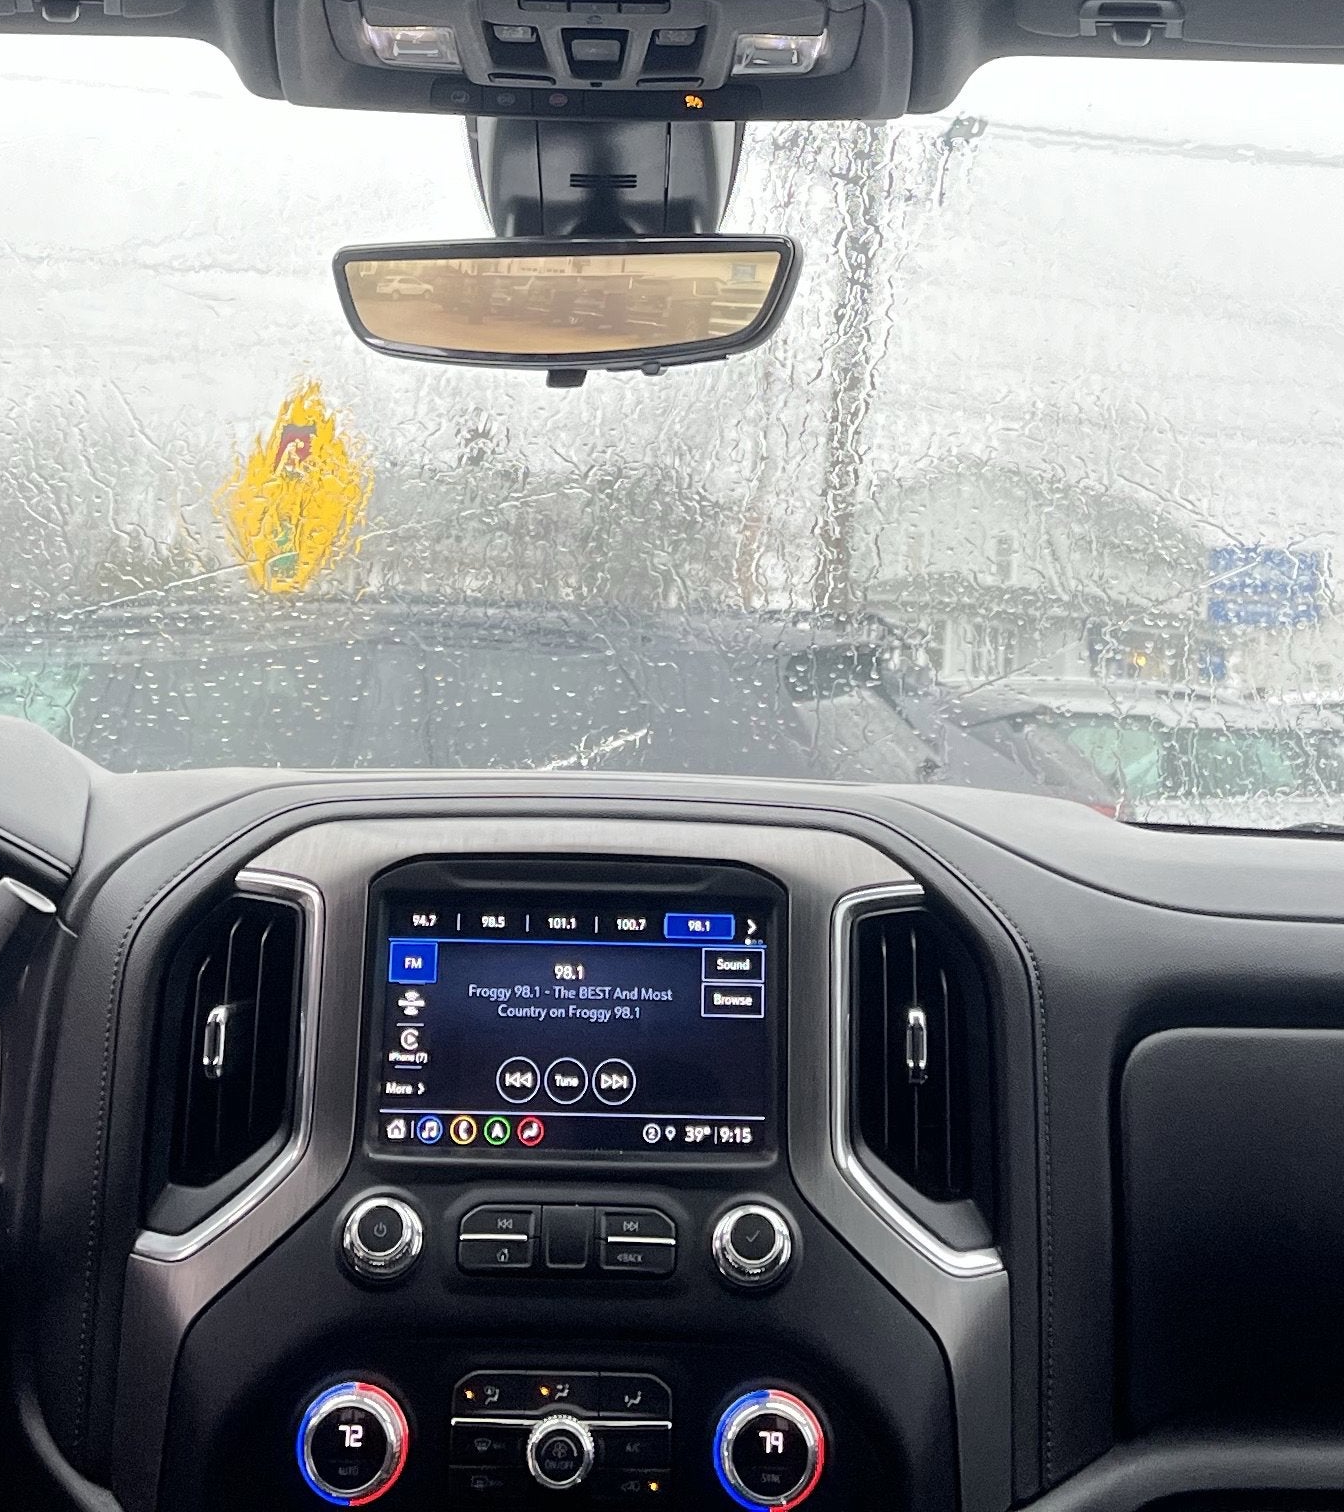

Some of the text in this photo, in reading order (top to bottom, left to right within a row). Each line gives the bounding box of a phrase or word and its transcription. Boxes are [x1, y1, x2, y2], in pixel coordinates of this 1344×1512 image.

[412, 914, 437, 927] 94.7
[481, 916, 505, 928] 98.5
[548, 917, 576, 929] 101.1
[617, 918, 647, 931] 100.7
[688, 920, 710, 932] 98.1
[404, 957, 422, 969] FM
[716, 958, 751, 971] Sound
[554, 964, 585, 980] 98.1
[468, 984, 511, 1001] Froggy
[514, 985, 540, 999] 98.1
[553, 986, 576, 999] The
[579, 986, 612, 1000] BEST
[613, 987, 638, 1000] And
[641, 987, 673, 1001] Most
[713, 993, 753, 1006] Browse
[498, 1004, 641, 1022] Country on Froggy 98.1
[554, 1074, 579, 1087] Tune
[385, 1081, 413, 1095] More
[719, 1126, 753, 1144] 9:15
[338, 1424, 363, 1448] 72
